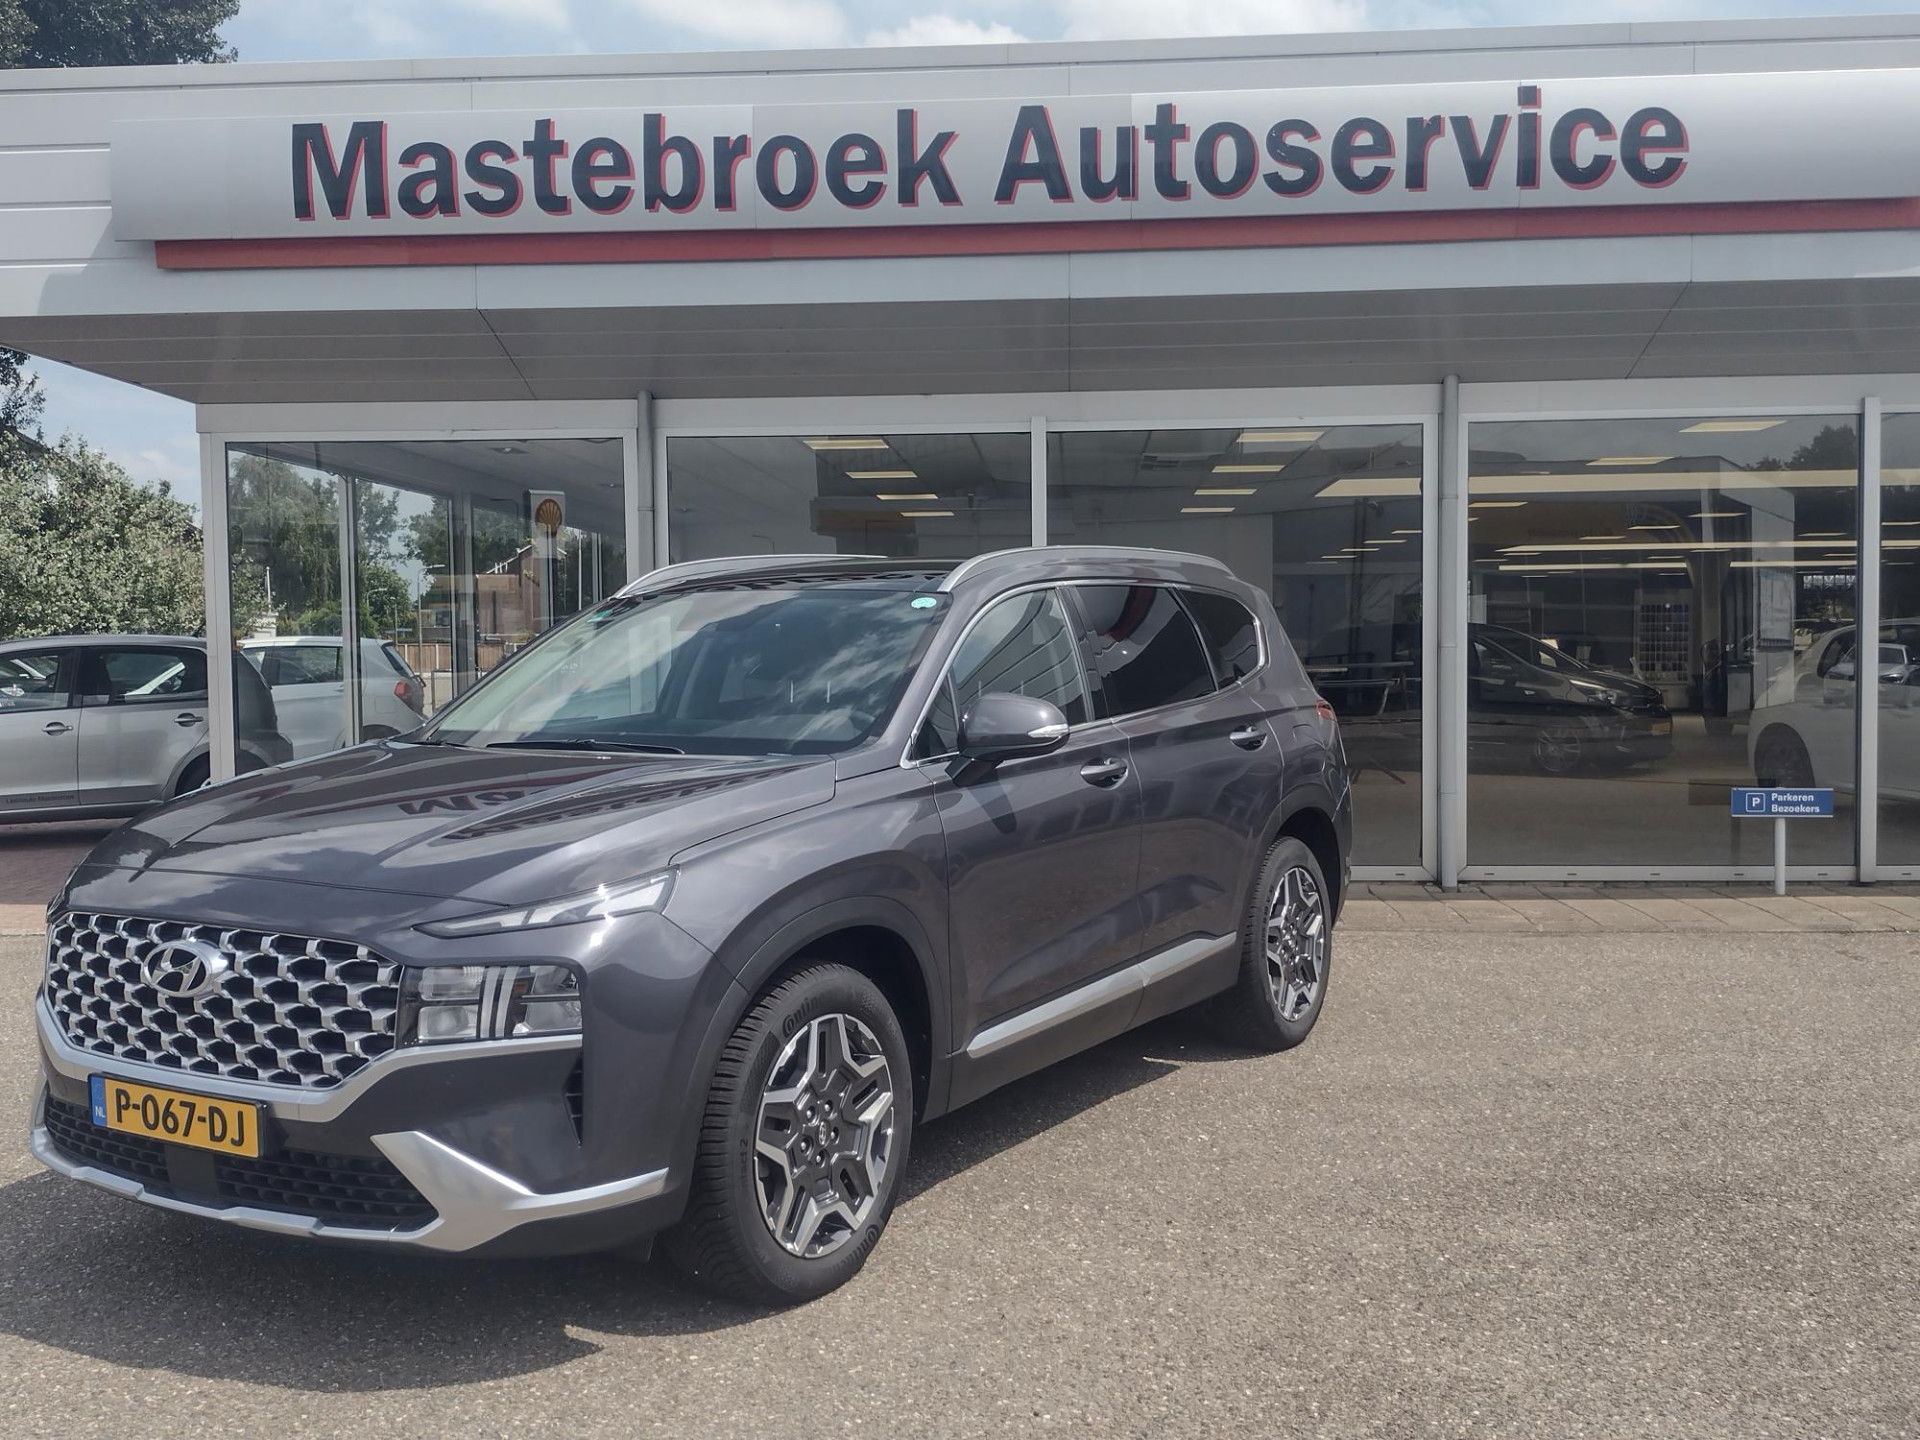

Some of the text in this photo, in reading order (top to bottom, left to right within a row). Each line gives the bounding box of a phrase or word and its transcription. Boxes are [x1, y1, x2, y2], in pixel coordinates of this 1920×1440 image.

[292, 85, 1690, 222] Mastebroek Autoservice
[1752, 797, 1761, 807] P
[1771, 792, 1814, 802] Parkeren
[1771, 804, 1820, 813] Bezoekers
[95, 1105, 106, 1119] NL
[115, 1087, 245, 1147] P-067-DJ
